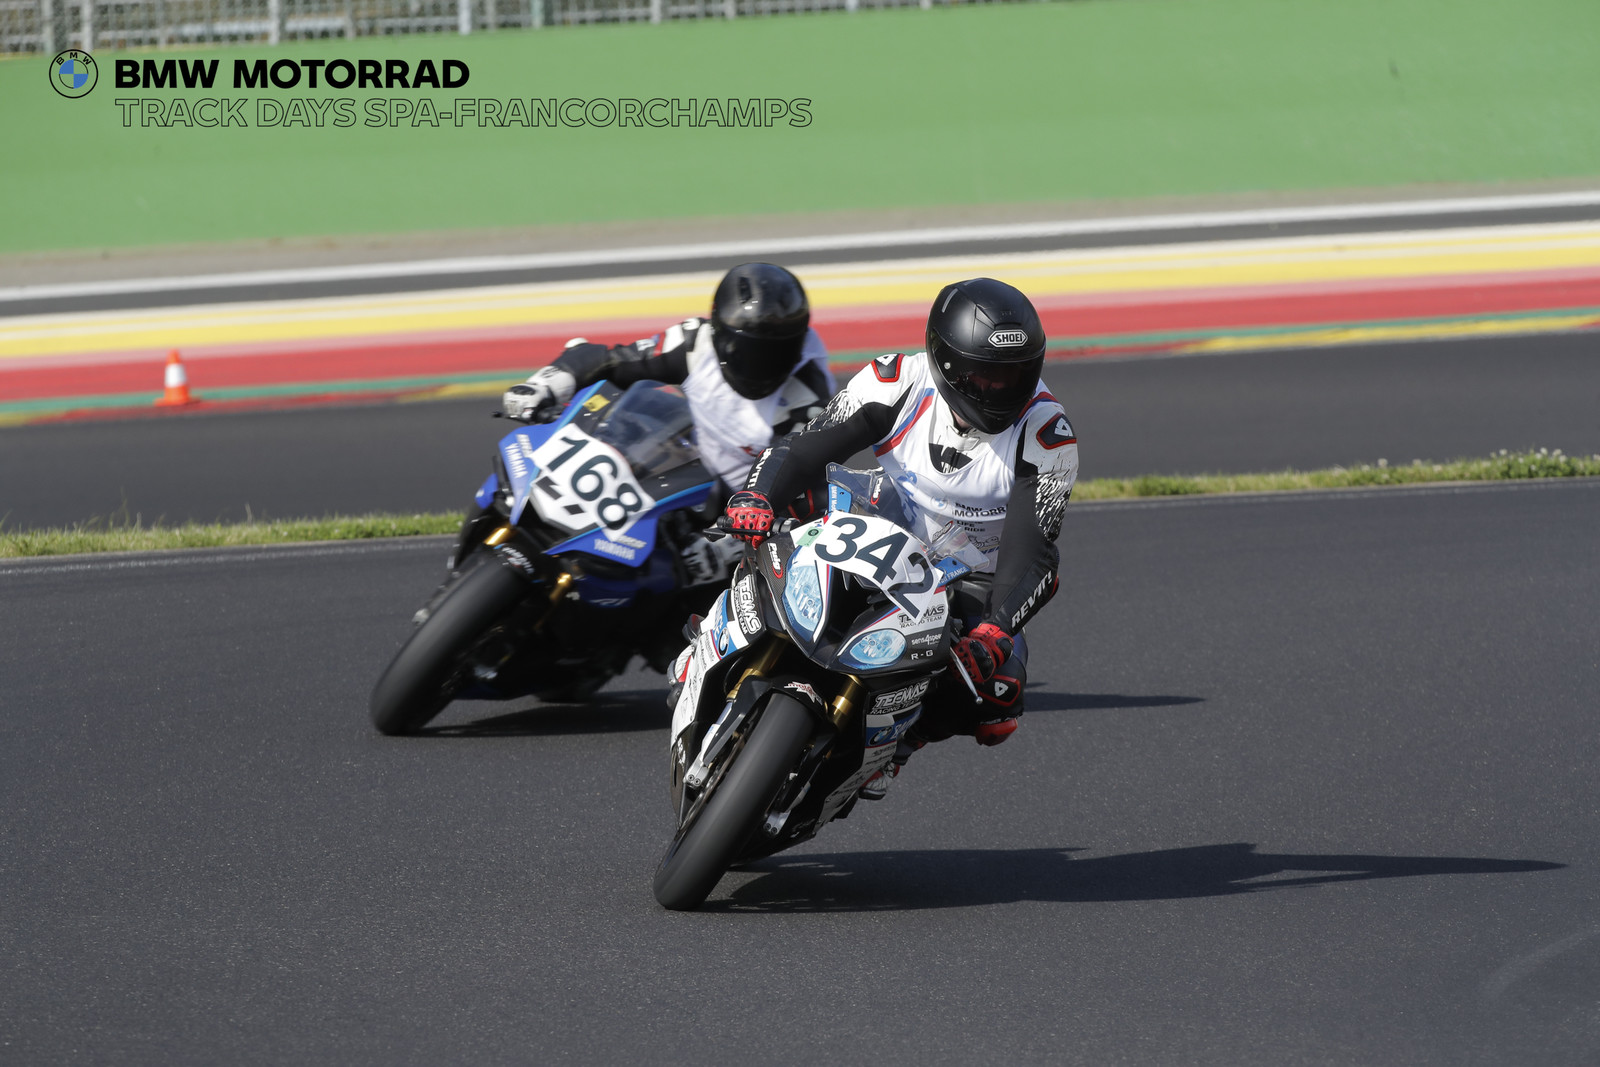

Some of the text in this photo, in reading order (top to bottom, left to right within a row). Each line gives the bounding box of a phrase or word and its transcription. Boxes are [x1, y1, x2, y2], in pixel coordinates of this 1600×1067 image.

[995, 333, 1023, 344] SHOEI
[504, 442, 529, 479] YAMAHA
[546, 436, 643, 531] 168
[814, 516, 934, 619] 342
[737, 573, 762, 635] TECMAS
[875, 678, 931, 709] TECMAS
